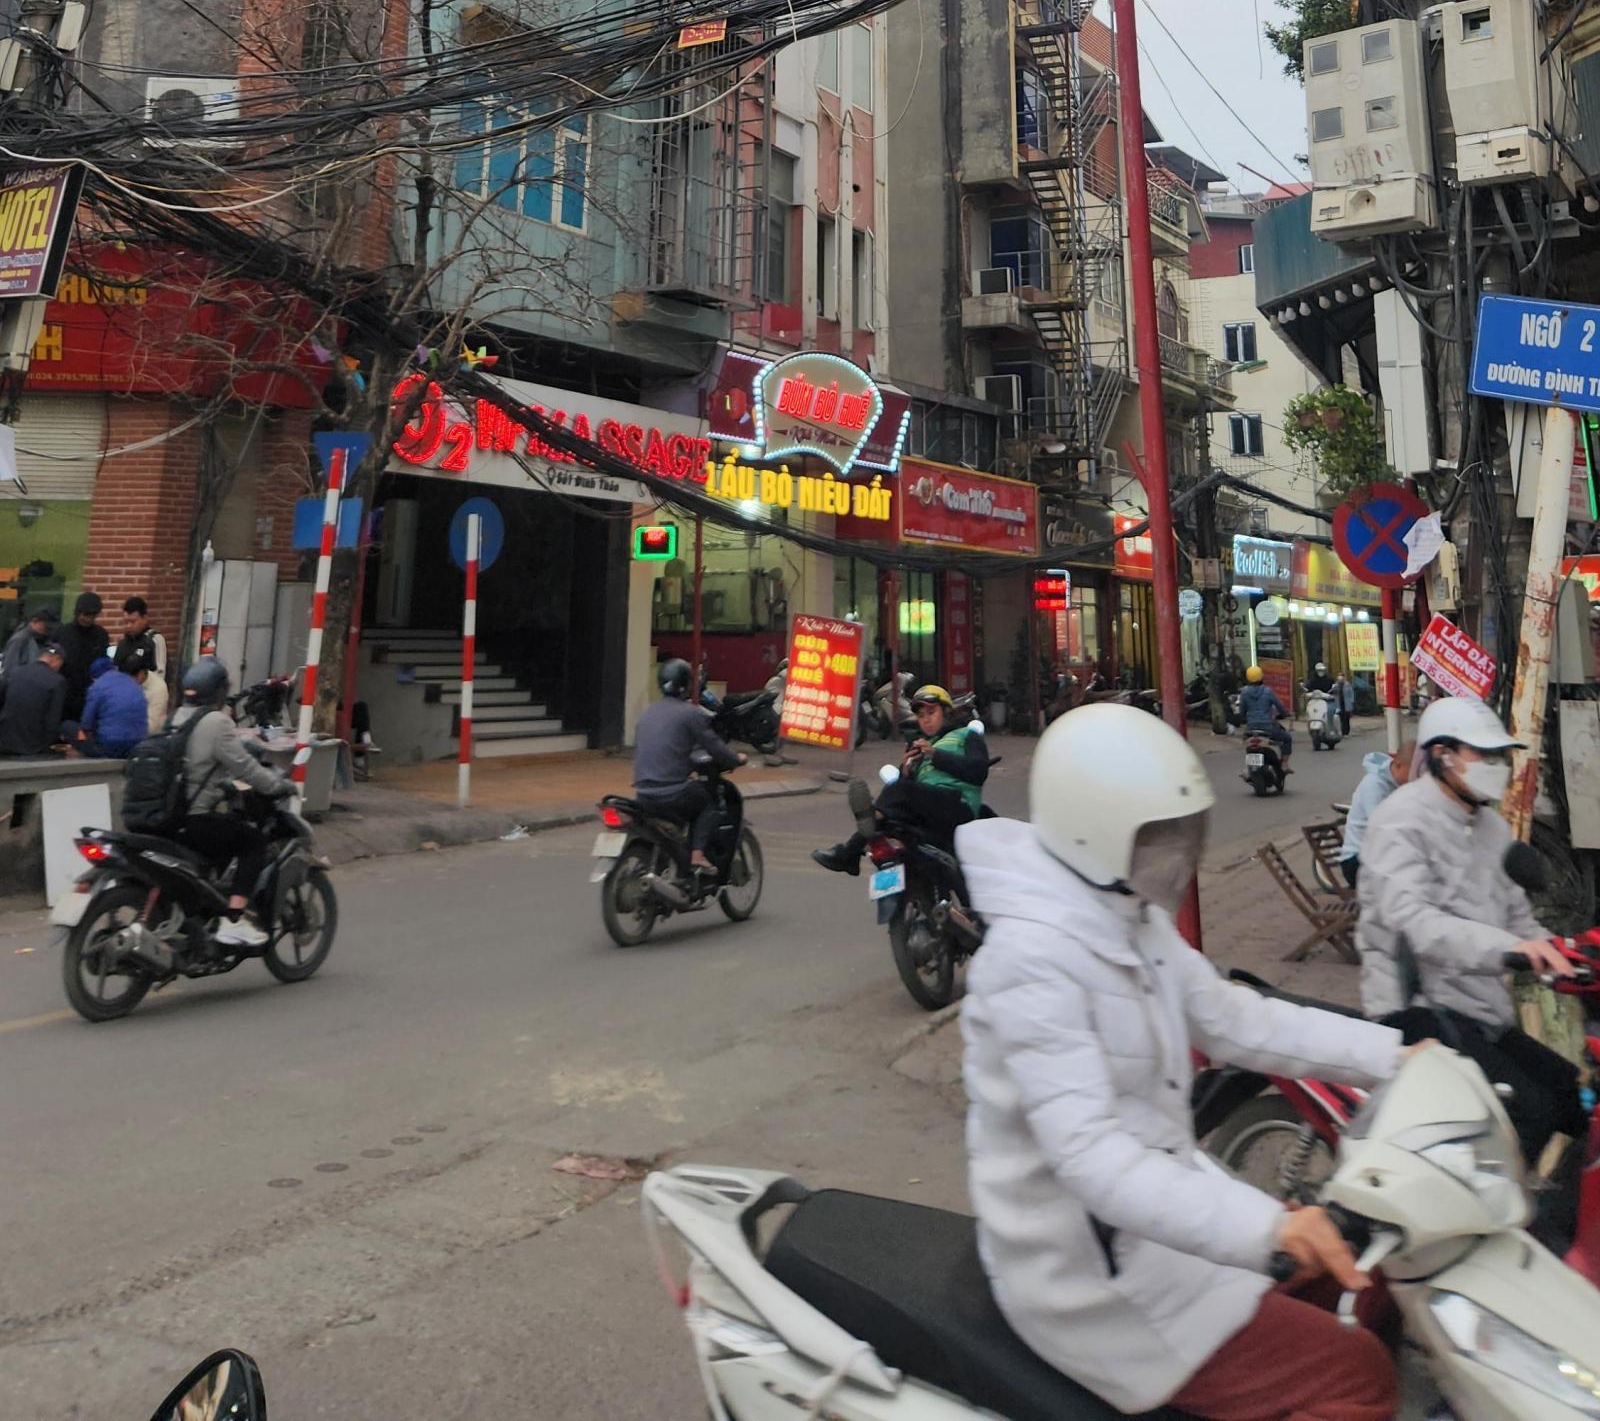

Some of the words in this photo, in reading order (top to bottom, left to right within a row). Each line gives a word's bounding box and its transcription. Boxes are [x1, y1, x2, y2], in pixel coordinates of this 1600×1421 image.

[0, 185, 55, 253] HOTEL
[31, 324, 62, 361] H
[1520, 310, 1562, 348] NGÕ
[1580, 319, 1596, 352] 2
[776, 373, 815, 418] BÚN
[812, 381, 840, 422] BÒ
[1487, 360, 1541, 388] ĐƯỜNG
[1544, 367, 1584, 394] ĐÌNH
[705, 447, 755, 500] LẨU
[760, 464, 794, 508] BÒ
[799, 472, 850, 516] NIÊU
[853, 474, 893, 520] ĐẤT
[1426, 631, 1491, 687] INTERNET
[1441, 626, 1470, 651] LẮP
[1467, 647, 1497, 674] ĐẶT
